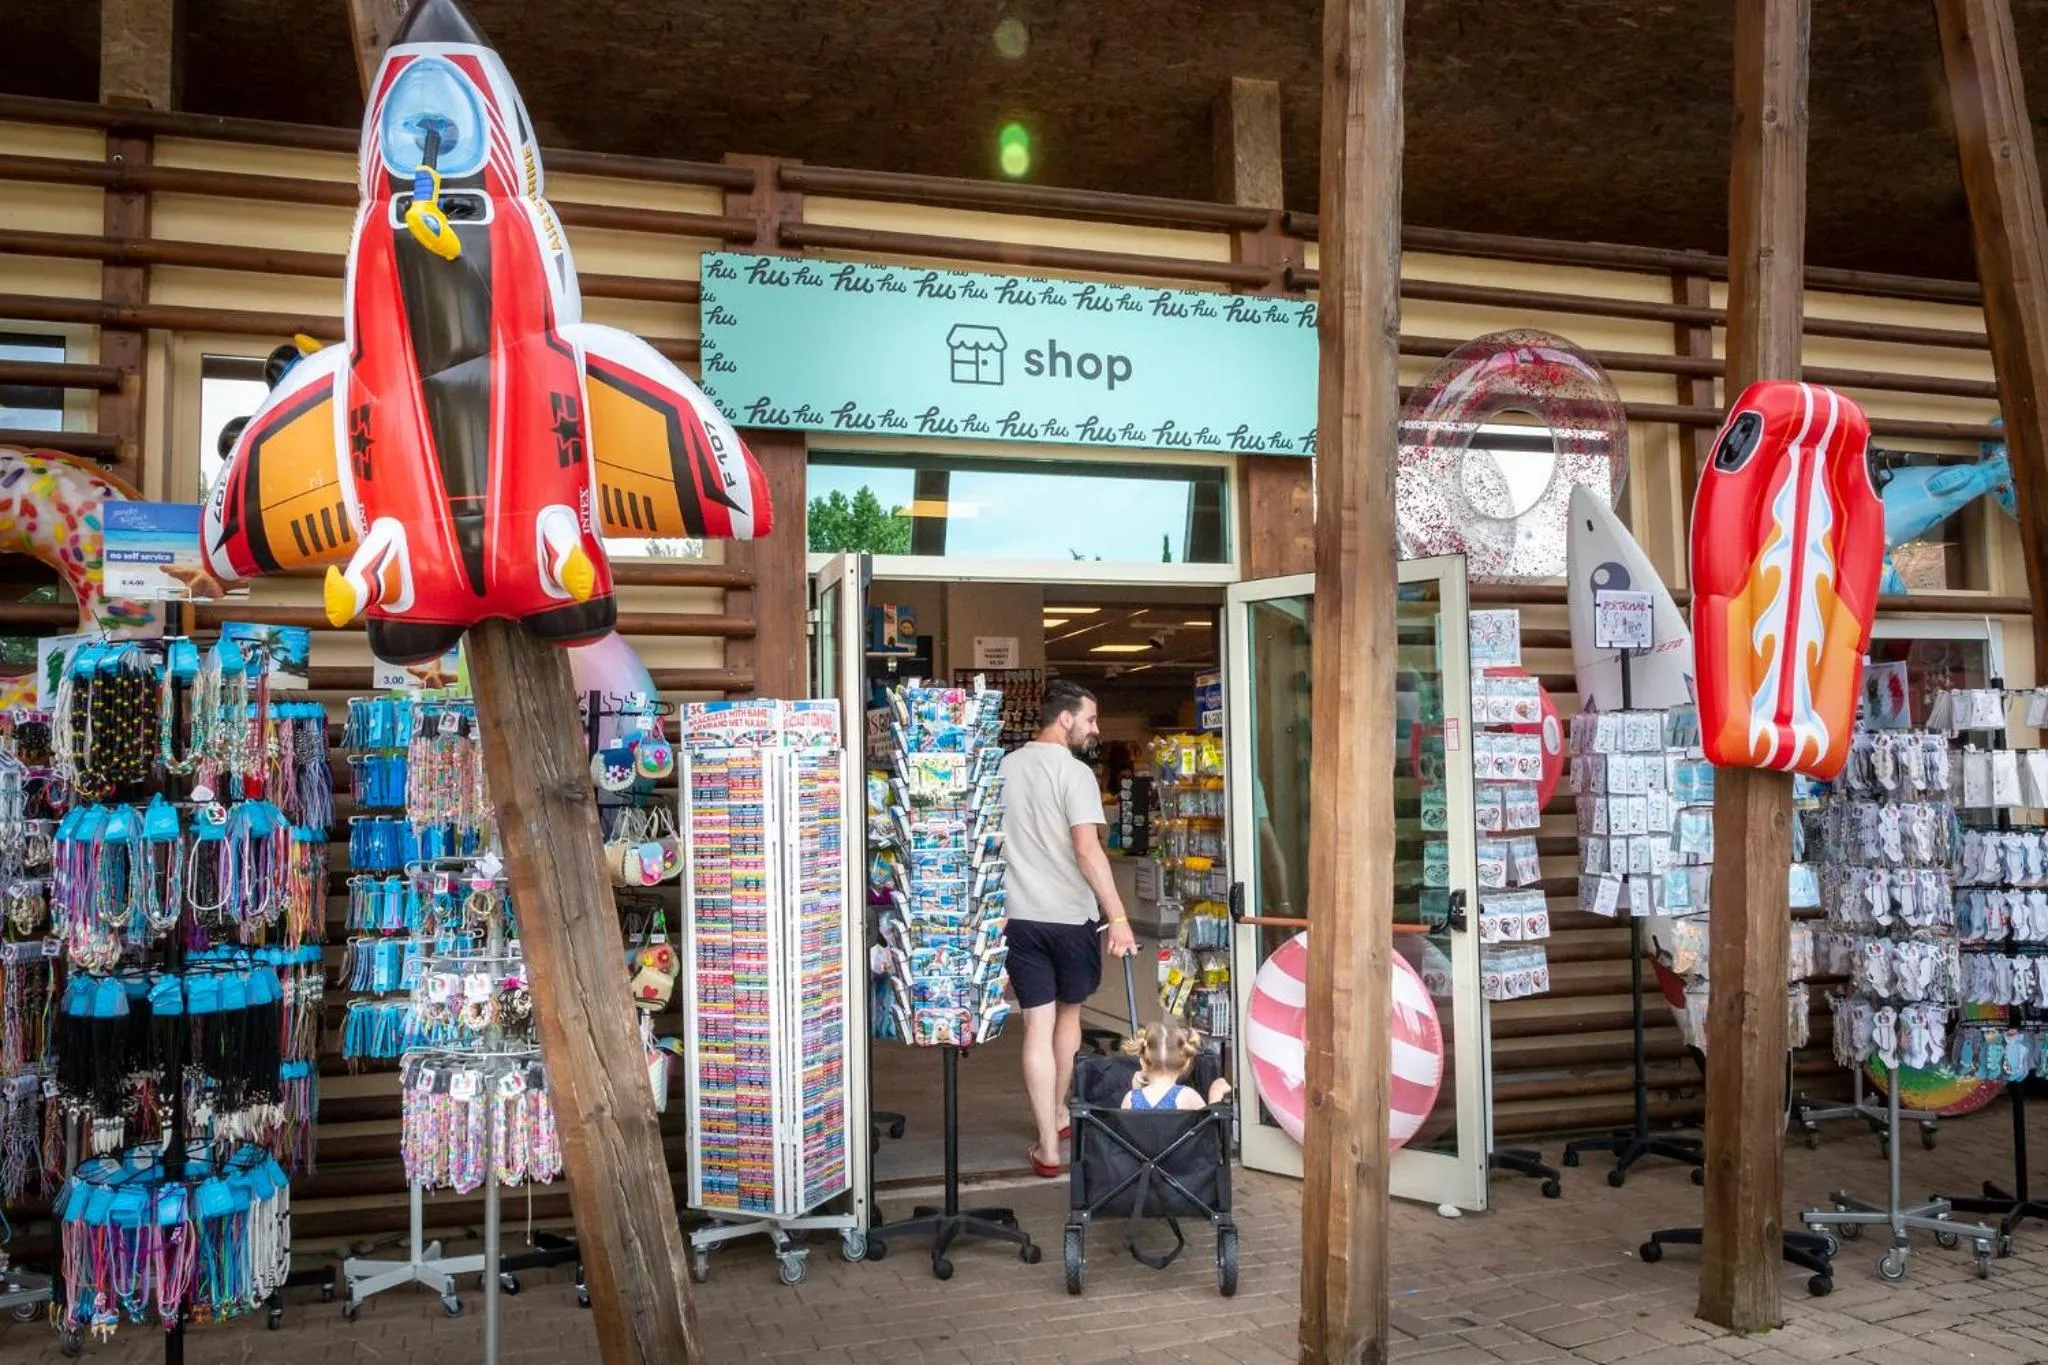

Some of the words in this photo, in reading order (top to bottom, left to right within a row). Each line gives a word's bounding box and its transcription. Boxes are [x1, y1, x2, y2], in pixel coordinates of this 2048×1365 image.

[705, 259, 736, 279] hu
[744, 258, 789, 286] hu
[792, 266, 823, 286] hu
[830, 265, 874, 293] hu
[876, 274, 906, 292] hu
[914, 272, 956, 299] hu
[959, 281, 988, 298] hu
[995, 279, 1036, 306] hu
[1041, 286, 1068, 306] hu
[1073, 285, 1114, 312] hu
[1116, 294, 1142, 311] hu
[1149, 292, 1188, 319] hu
[1191, 300, 1217, 317] hu
[1223, 298, 1261, 324] hu
[1263, 306, 1289, 323] hu
[704, 306, 736, 326] hu
[705, 352, 736, 373] hu
[1023, 338, 1133, 391] shop
[704, 420, 728, 465] 107
[744, 397, 790, 426] hu
[793, 404, 823, 423] hu
[831, 402, 875, 430] hu
[878, 410, 908, 428] hu
[915, 407, 957, 434] hu
[962, 413, 989, 433] hu
[996, 412, 1038, 439] hu
[1041, 419, 1069, 437] hu
[1075, 416, 1115, 442] hu
[1118, 423, 1147, 442] hu
[1152, 420, 1192, 447] hu
[1195, 427, 1222, 446] hu
[1228, 425, 1264, 451] hu
[1268, 432, 1294, 450] hu
[579, 485, 592, 535] INTEX
[109, 552, 122, 560] no
[123, 551, 140, 560] self
[140, 552, 171, 561] service
